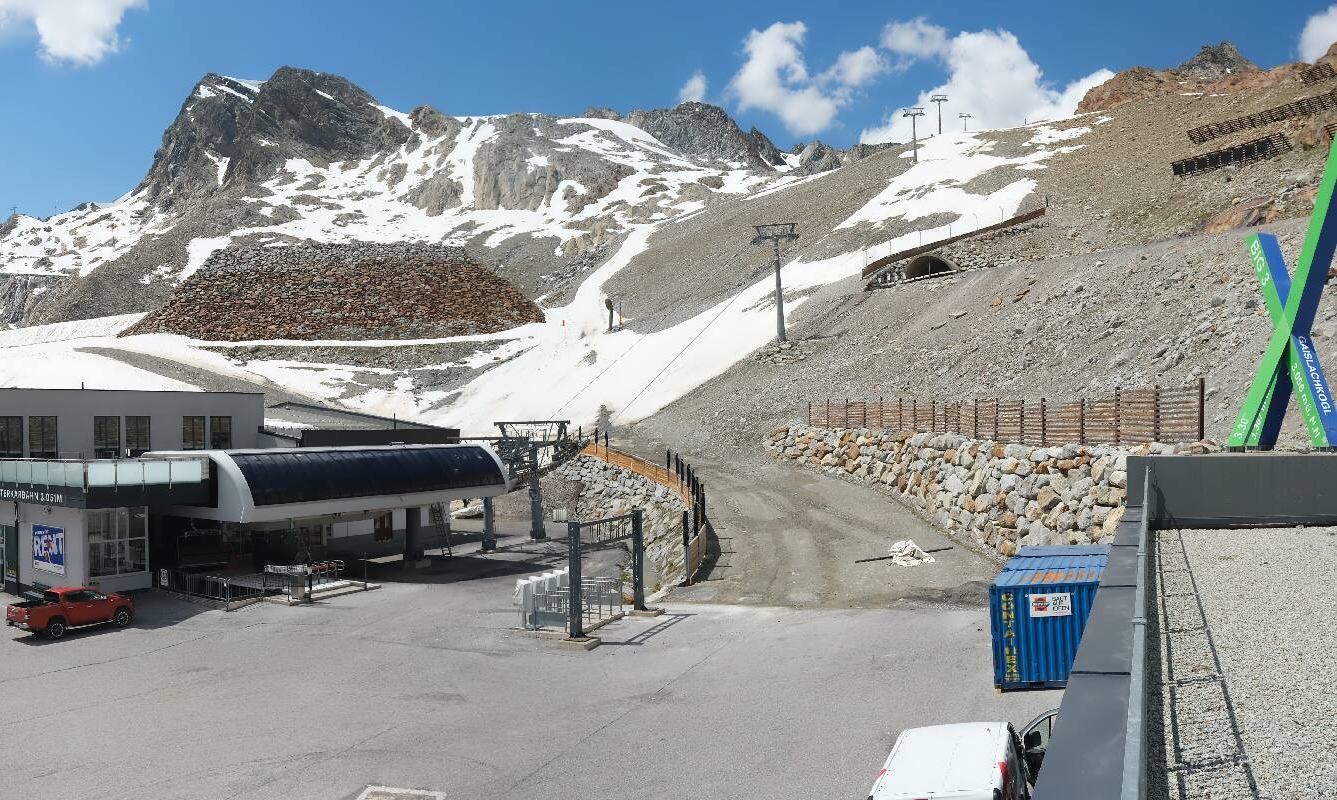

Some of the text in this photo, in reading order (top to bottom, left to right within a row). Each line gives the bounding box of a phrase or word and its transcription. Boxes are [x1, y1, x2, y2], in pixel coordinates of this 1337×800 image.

[1250, 239, 1270, 286] BIG 3
[1298, 335, 1332, 415] GAISLACHKOGL
[1234, 414, 1249, 439] 3.30
[33, 533, 64, 556] RENT
